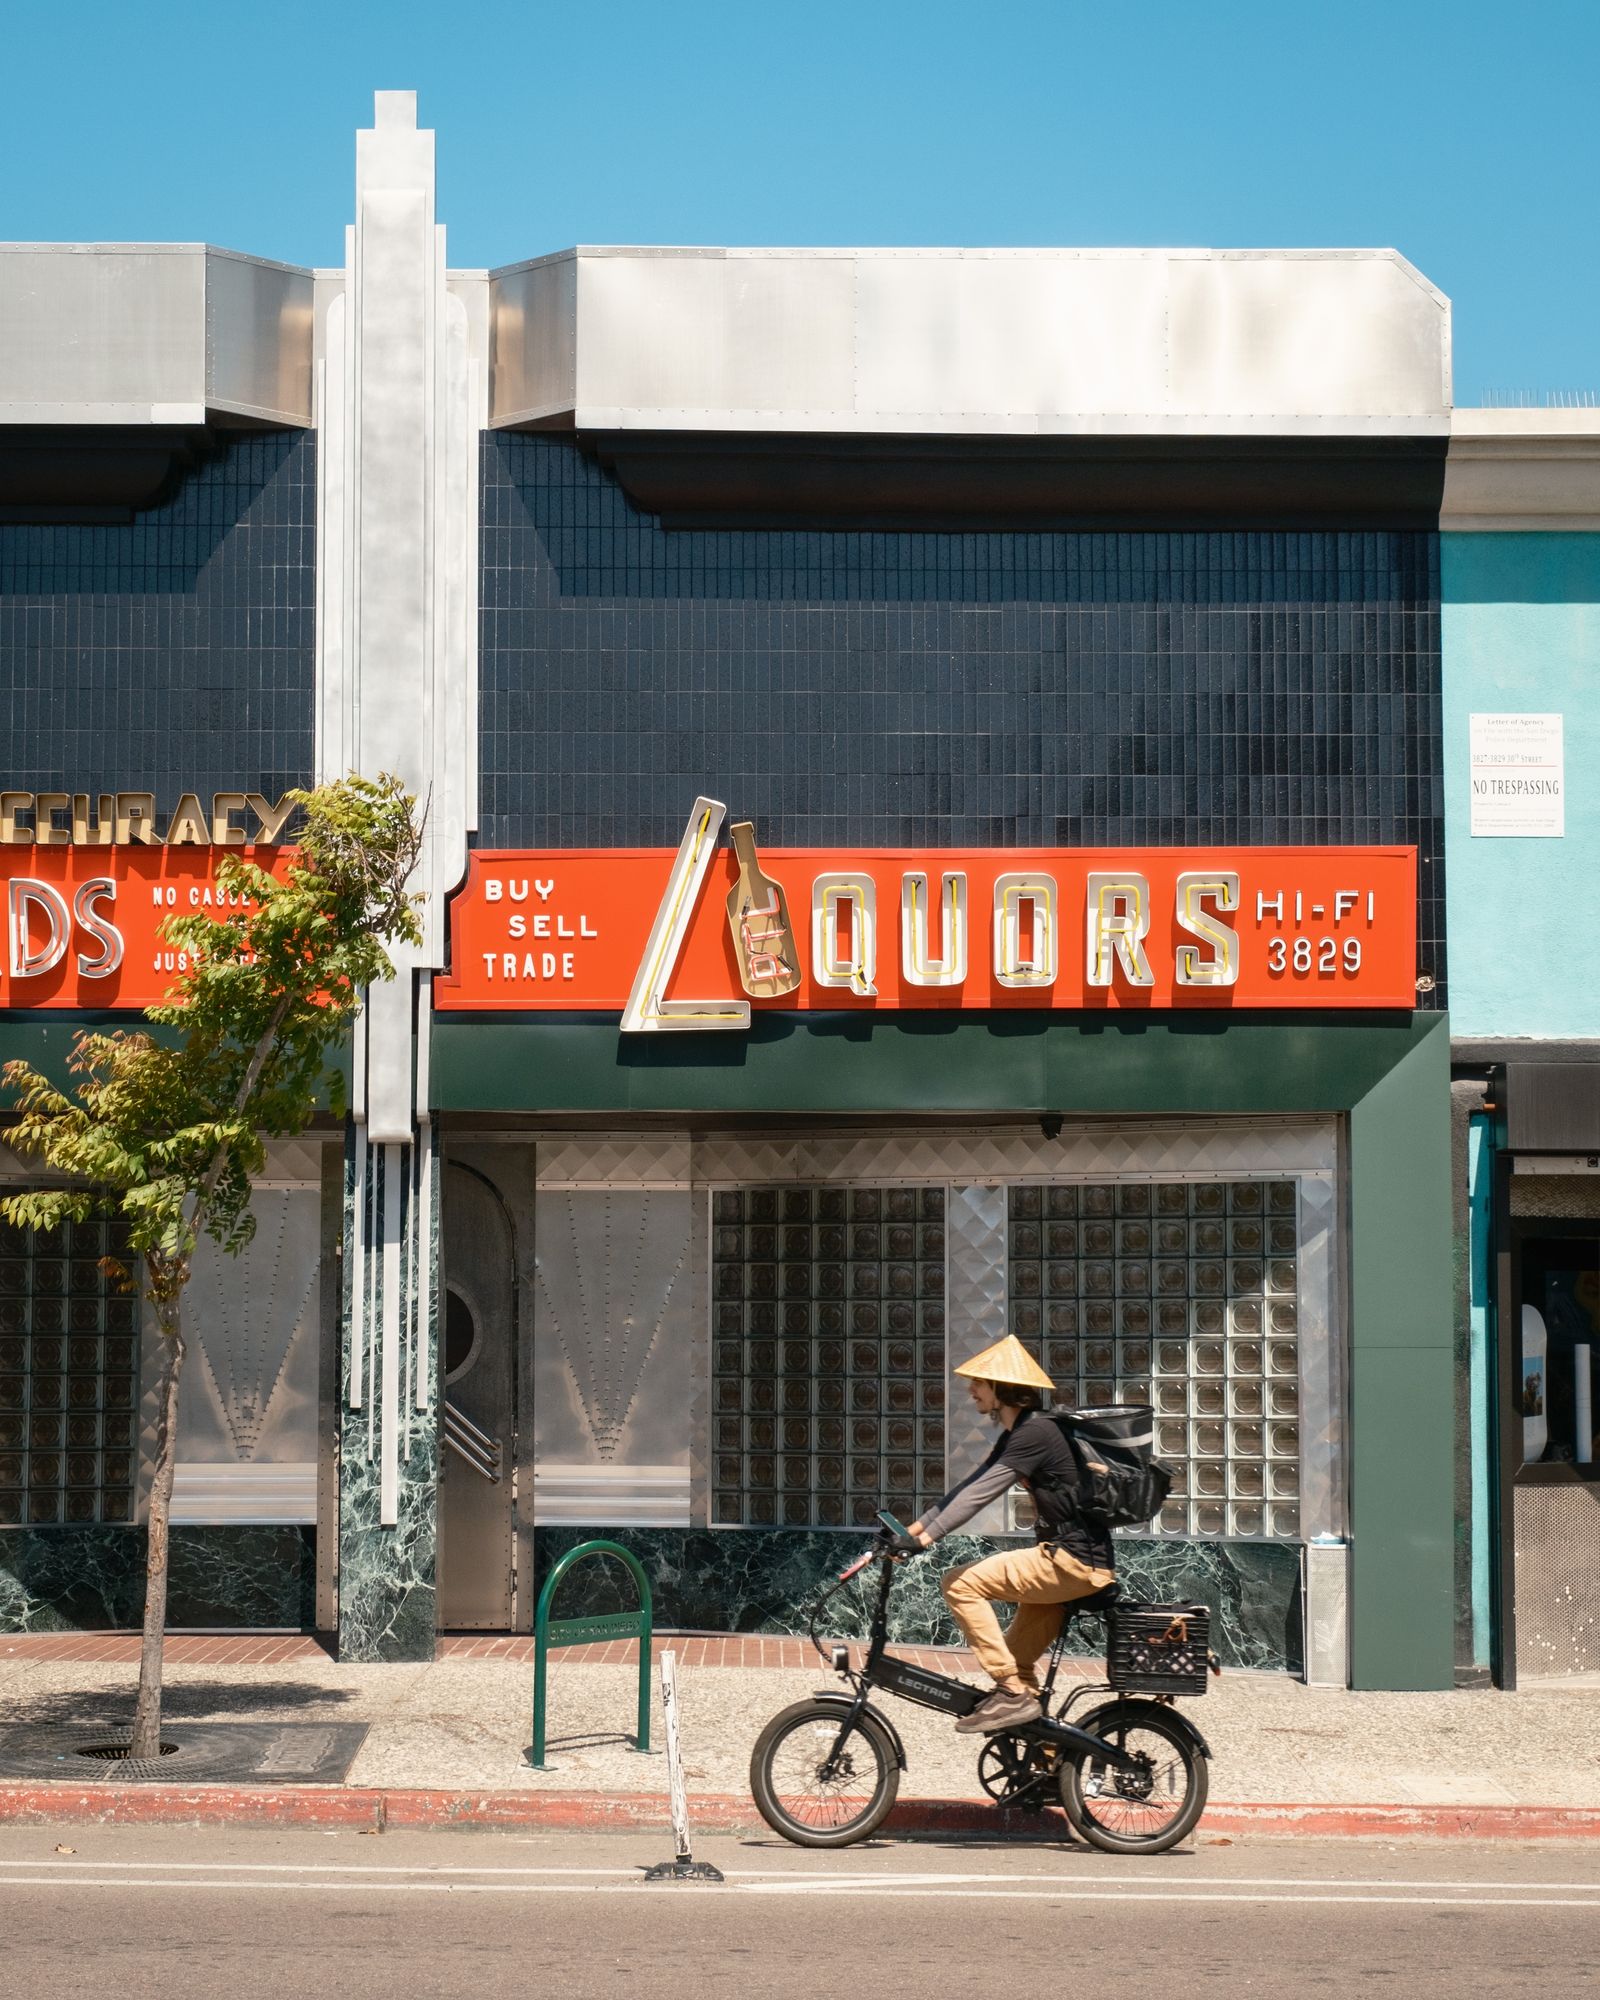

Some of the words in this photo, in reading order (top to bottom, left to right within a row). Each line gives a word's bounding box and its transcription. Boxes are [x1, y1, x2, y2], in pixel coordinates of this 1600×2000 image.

[1519, 719, 1544, 727] Agency
[1473, 779, 1488, 795] NO
[1490, 779, 1560, 795] TRESPASSING
[152, 886, 177, 906] NO
[485, 879, 556, 902] BUY
[1256, 889, 1375, 922] HI-FI
[0, 876, 125, 979] DS
[508, 914, 599, 938] SELL
[482, 952, 576, 980] TRADE
[1268, 936, 1363, 973] 3829
[549, 1627, 571, 1641] CITY
[574, 1625, 586, 1638] OF
[589, 1623, 609, 1636] SAN
[610, 1619, 640, 1634] DIEGO
[897, 1675, 952, 1700] LECTRIC
